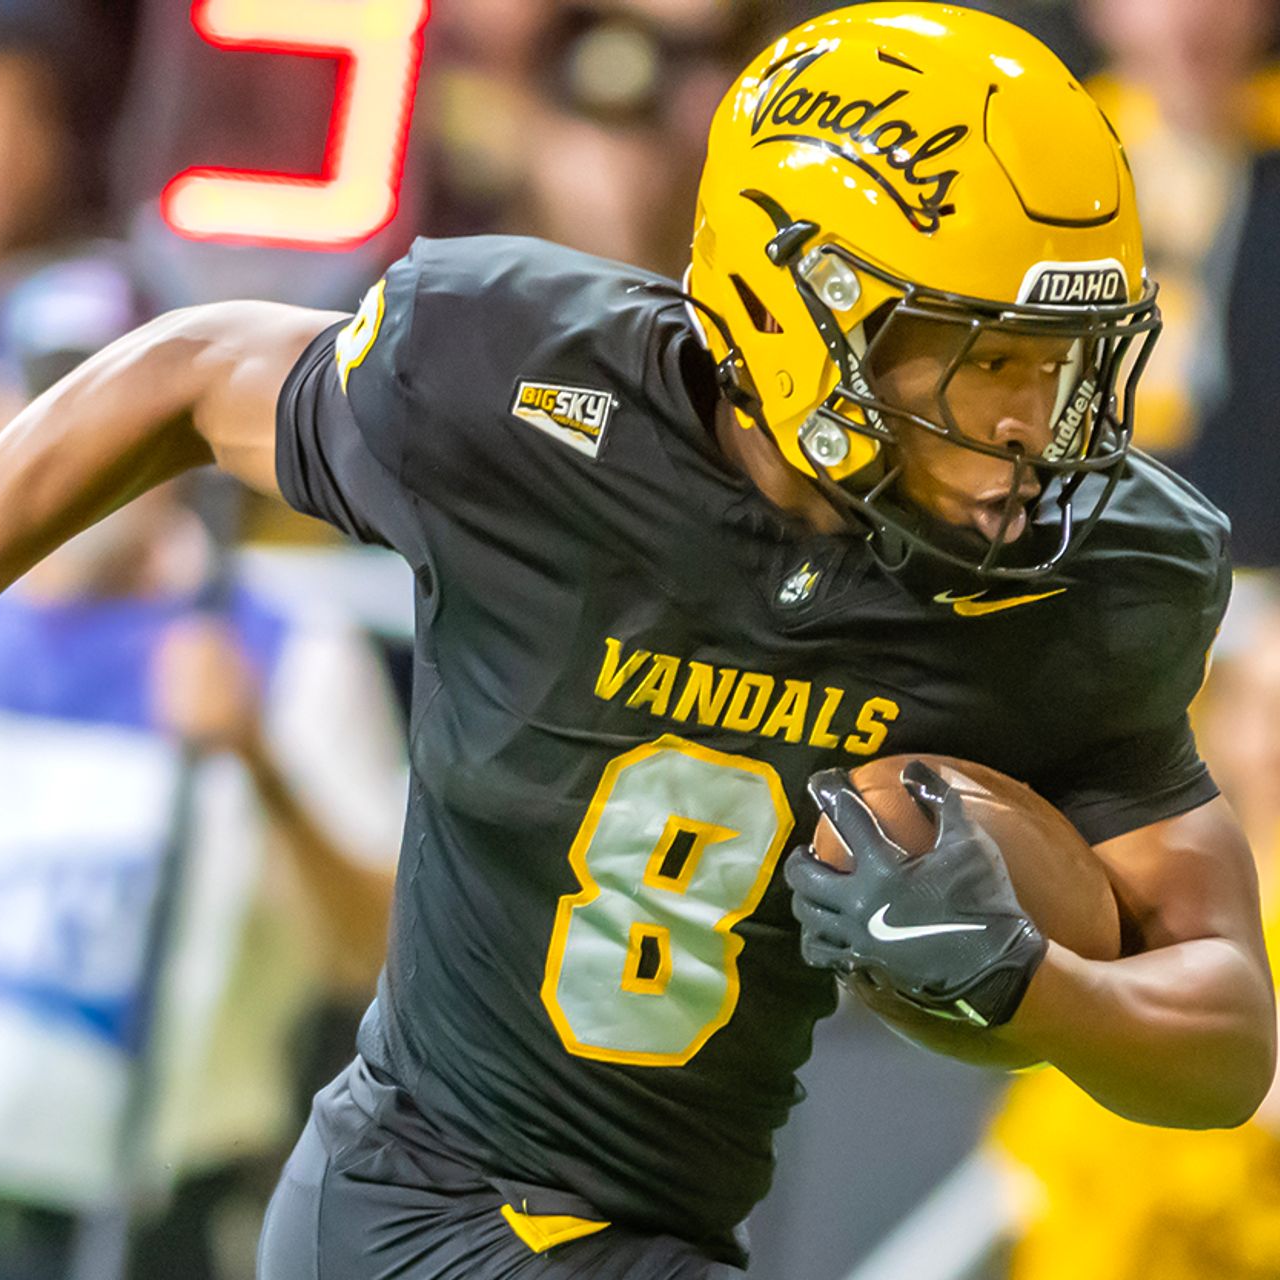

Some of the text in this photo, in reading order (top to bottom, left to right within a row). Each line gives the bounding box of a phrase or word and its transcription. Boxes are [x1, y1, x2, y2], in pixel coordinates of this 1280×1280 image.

[749, 46, 969, 233] Vandals
[1040, 272, 1120, 301] IDAHO
[1042, 379, 1097, 462] Riddell
[594, 637, 900, 756] VANDALS
[540, 733, 796, 1067] 8
